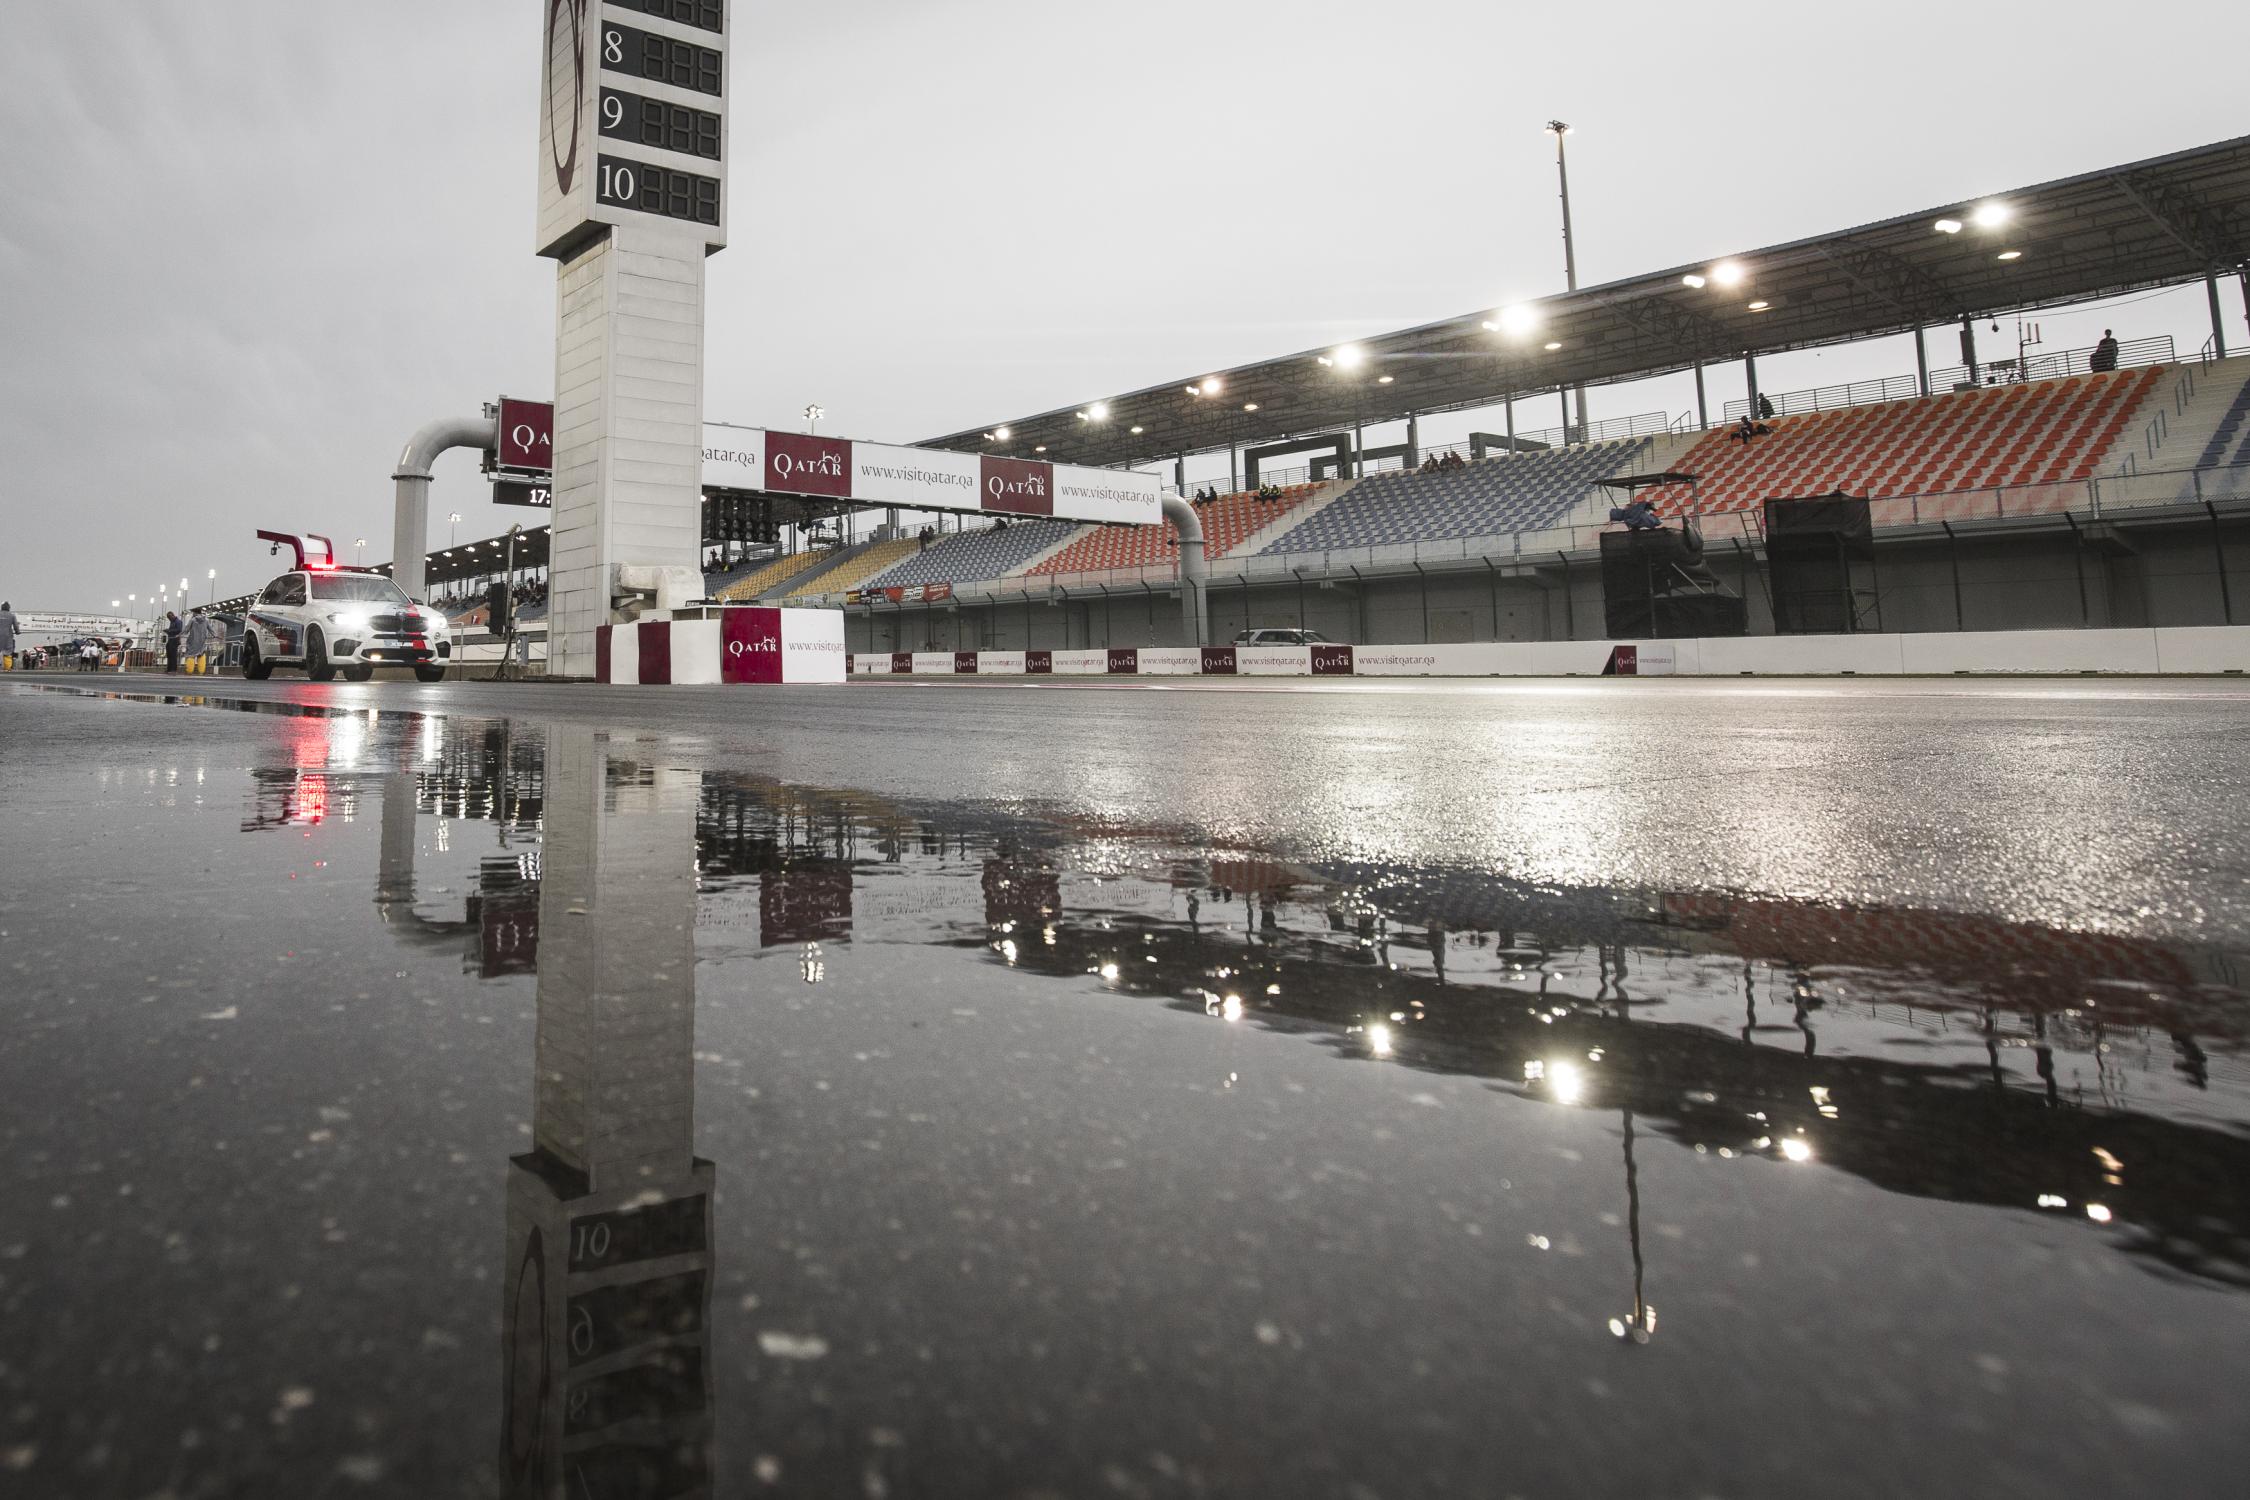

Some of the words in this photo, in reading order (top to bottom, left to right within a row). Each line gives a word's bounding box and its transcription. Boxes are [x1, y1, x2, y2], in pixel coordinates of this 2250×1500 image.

[605, 30, 623, 63] 8
[603, 96, 623, 129] 9
[601, 164, 635, 201] 10
[513, 424, 551, 455] QA
[773, 450, 842, 480] QATAR
[861, 465, 973, 489] www.visitqatar.qa
[988, 473, 1045, 501] QATAR
[1061, 485, 1155, 506] www.visitqatar.qa
[729, 636, 777, 658] QATAR
[1204, 654, 1234, 669] QATAR
[1242, 655, 1307, 667] www.visitqatar.qa
[1315, 653, 1350, 670] QATAR
[1358, 655, 1435, 667] www.visitqatar.qa
